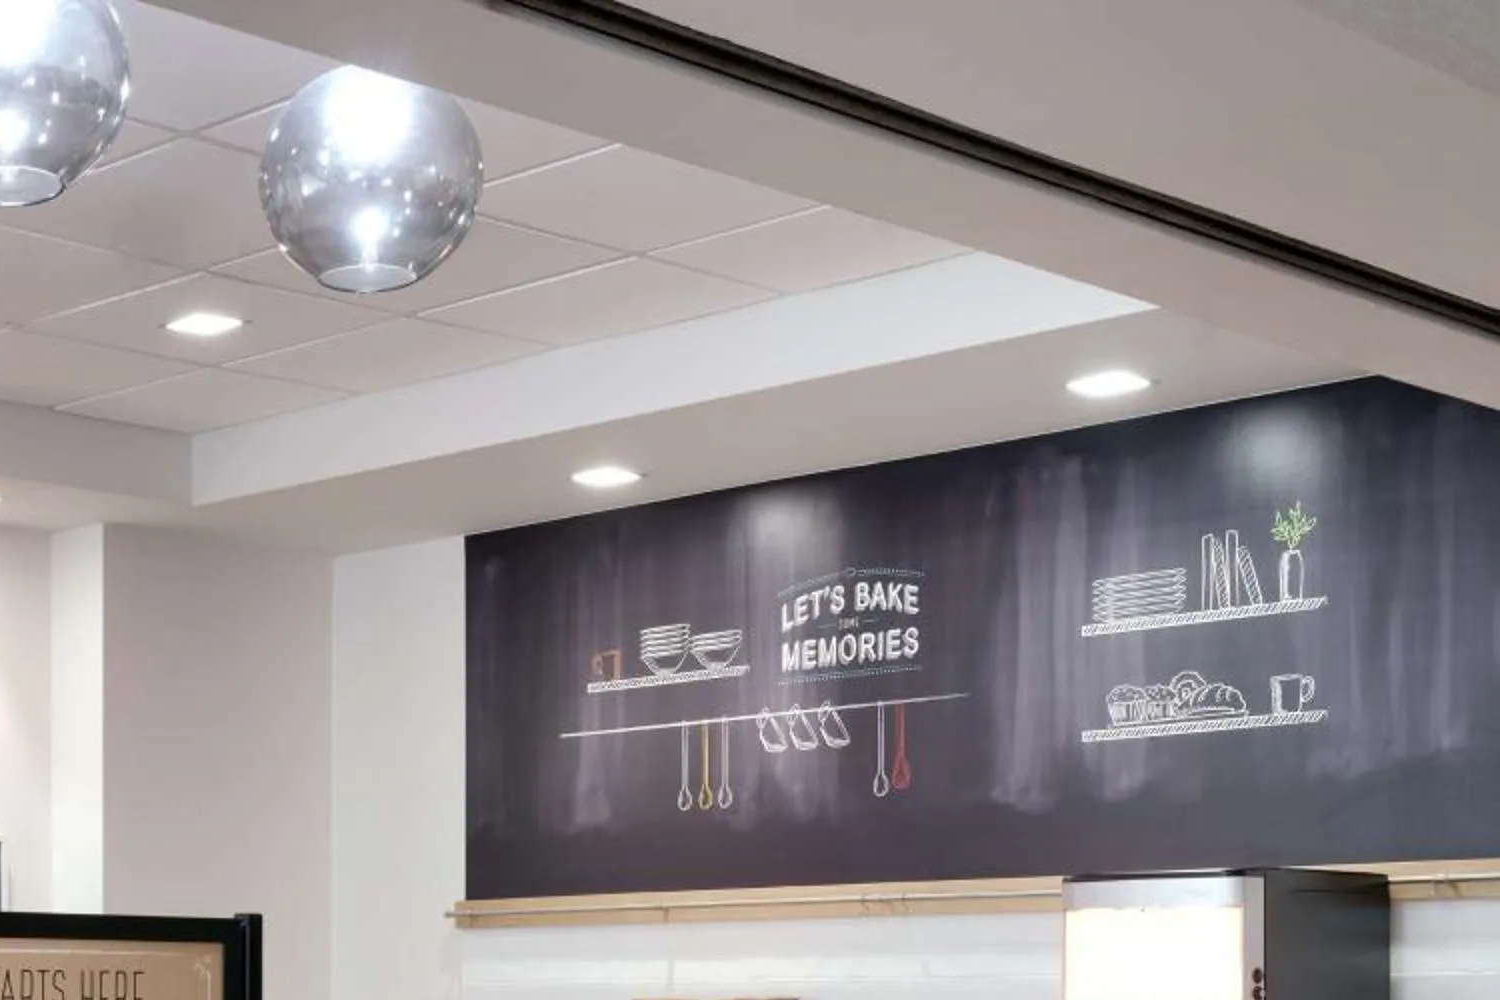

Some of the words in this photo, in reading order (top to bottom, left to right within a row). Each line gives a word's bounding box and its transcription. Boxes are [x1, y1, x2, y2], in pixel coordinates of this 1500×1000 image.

[781, 585, 845, 633] LET'S
[854, 581, 920, 615] BAKE
[781, 627, 920, 673] MEMORIES
